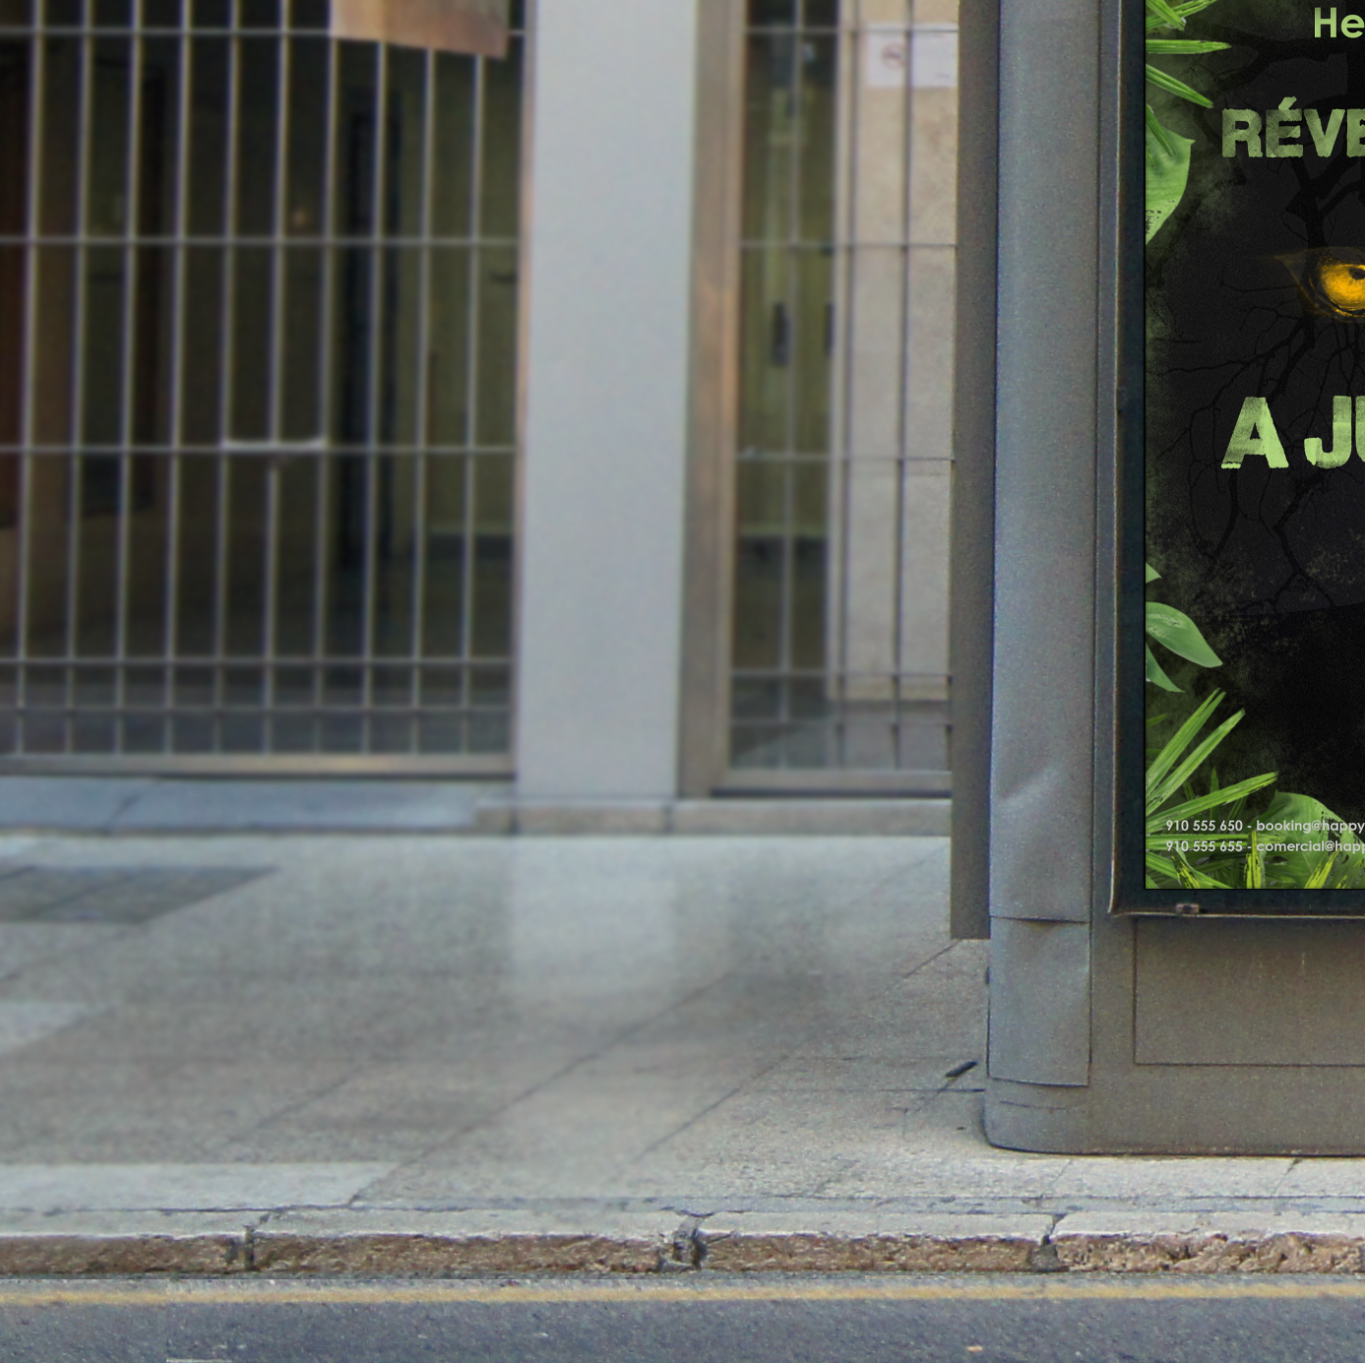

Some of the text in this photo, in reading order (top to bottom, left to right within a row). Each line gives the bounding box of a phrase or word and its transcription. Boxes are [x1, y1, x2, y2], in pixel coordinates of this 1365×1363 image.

[1221, 396, 1289, 469] A
[1166, 820, 1189, 831] 910
[1193, 820, 1216, 831] 555
[1220, 820, 1243, 831] 650
[1166, 840, 1189, 852] 910
[1193, 840, 1216, 852] 555
[1220, 840, 1243, 852] 655
